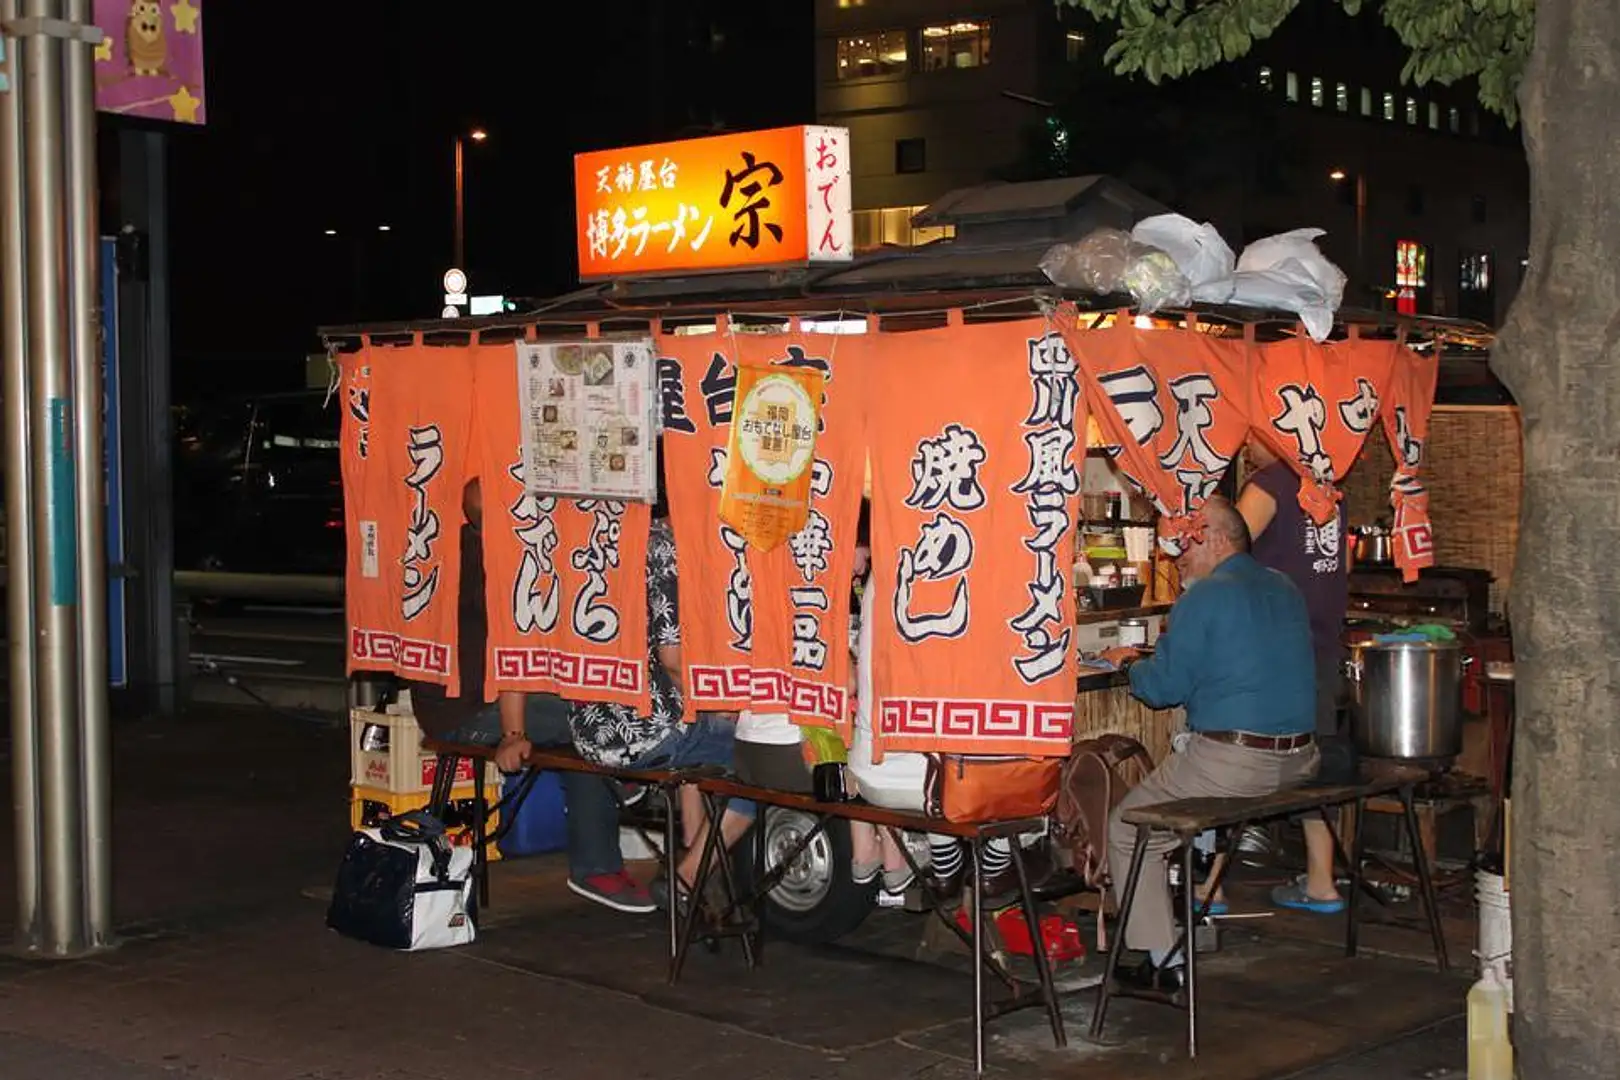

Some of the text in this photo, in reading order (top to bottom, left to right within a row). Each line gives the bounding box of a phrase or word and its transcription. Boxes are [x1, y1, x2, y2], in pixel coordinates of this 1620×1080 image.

[586, 202, 714, 260] 博多ラーメン
[595, 157, 679, 194] 天神屋台
[719, 151, 783, 249] 宗
[815, 136, 842, 252] おでん
[403, 423, 444, 622] ラーメン
[894, 424, 989, 643] 焼めし
[1009, 331, 1080, 683] 四川風ラーメン
